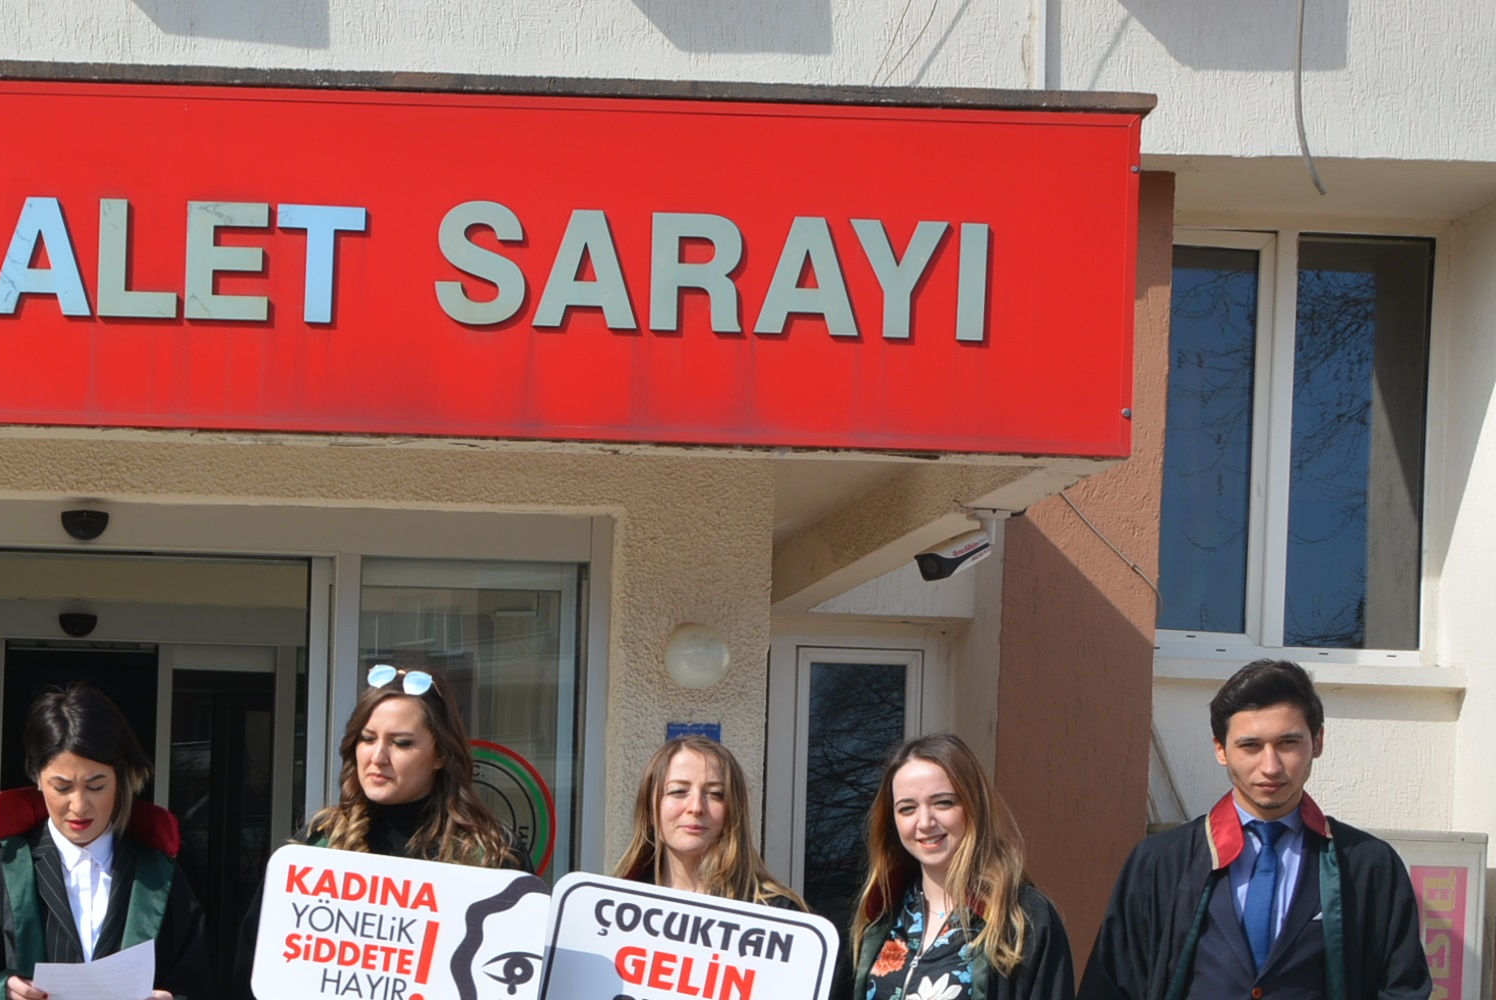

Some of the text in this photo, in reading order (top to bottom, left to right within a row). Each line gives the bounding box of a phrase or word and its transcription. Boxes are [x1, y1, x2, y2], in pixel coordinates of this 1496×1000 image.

[434, 200, 990, 343] SARAYI
[284, 864, 439, 913] KADINA
[593, 898, 795, 963] ÇOCUKTAN
